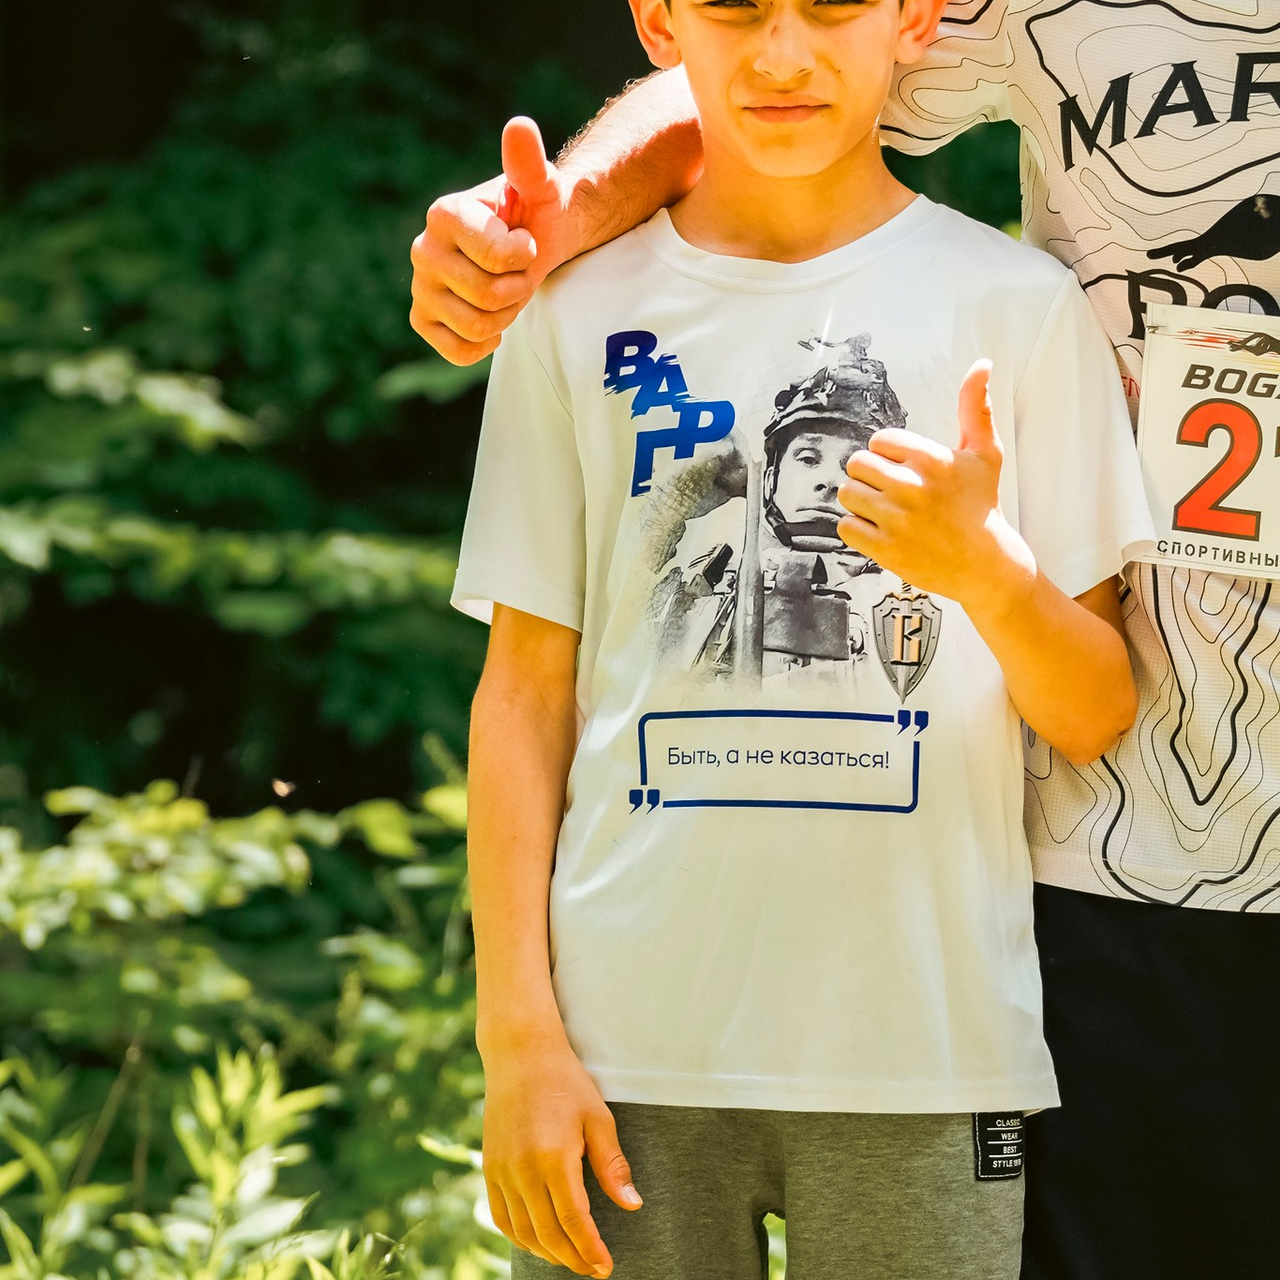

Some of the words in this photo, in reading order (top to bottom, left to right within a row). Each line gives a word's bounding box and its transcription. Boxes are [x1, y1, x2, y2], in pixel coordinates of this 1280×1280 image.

[667, 747, 721, 768] Быть,
[726, 748, 739, 764] а
[746, 748, 774, 764] не
[780, 748, 890, 769] казаться!
[1001, 1132, 1018, 1141] WEAR
[1002, 1146, 1017, 1154] BEST
[992, 1160, 1013, 1168] STYLE
